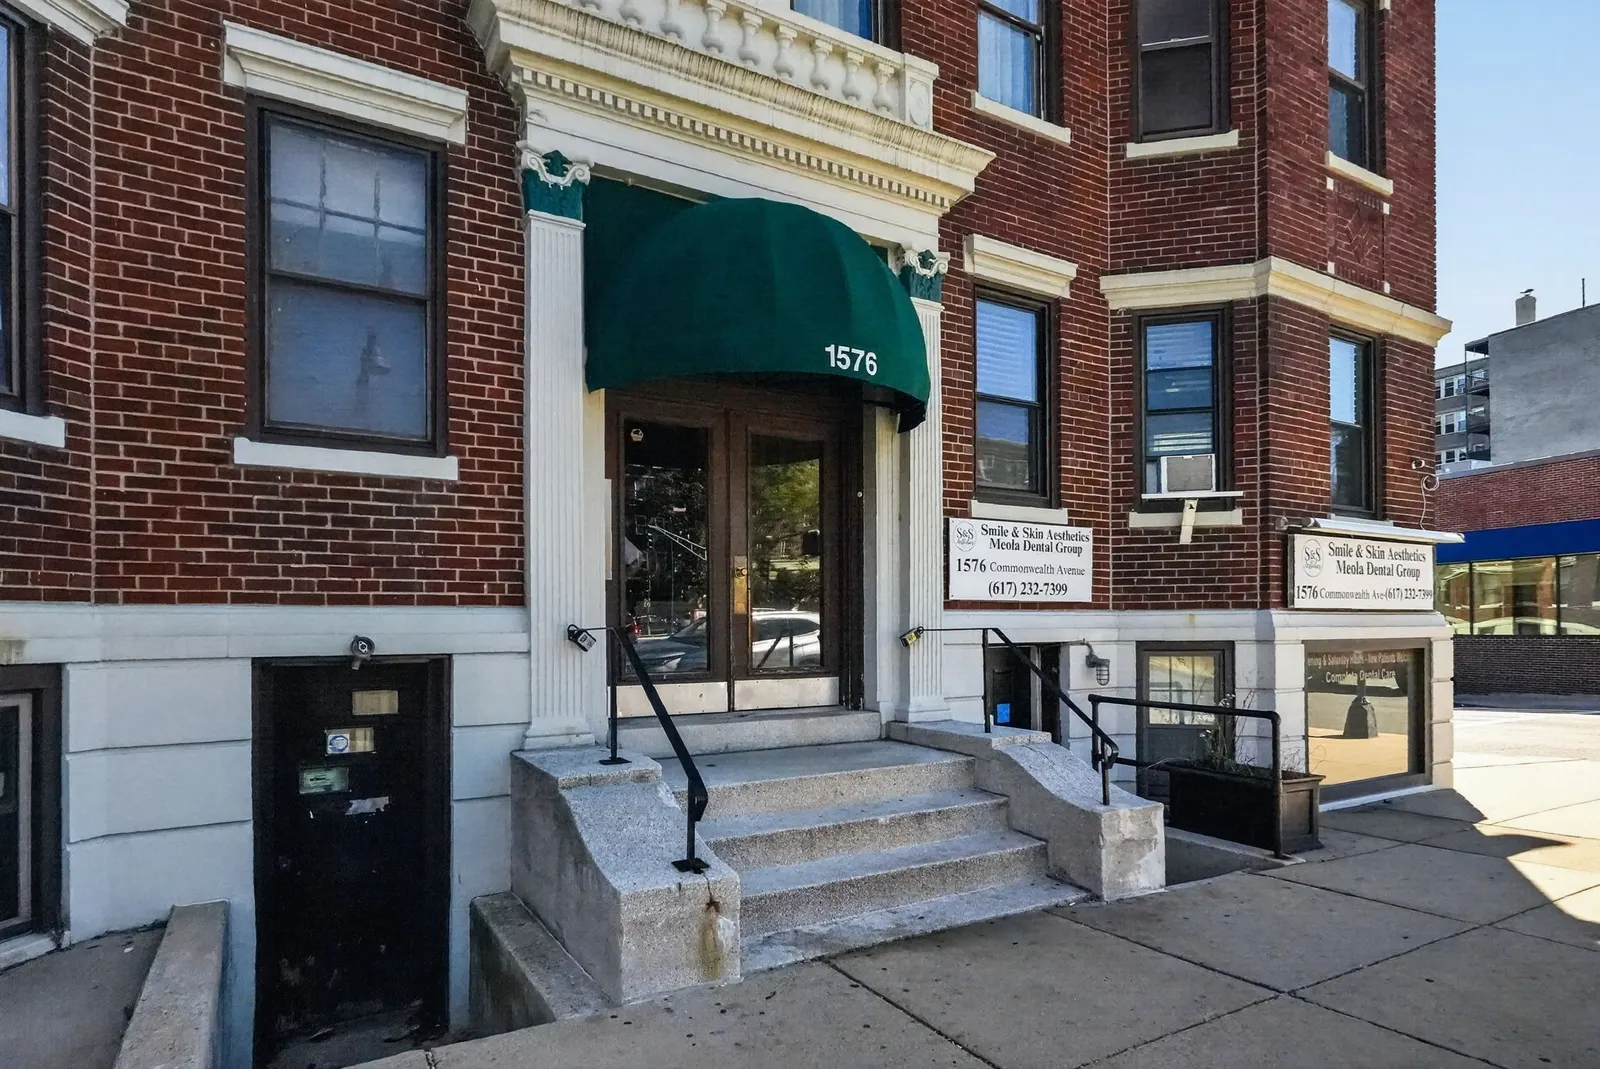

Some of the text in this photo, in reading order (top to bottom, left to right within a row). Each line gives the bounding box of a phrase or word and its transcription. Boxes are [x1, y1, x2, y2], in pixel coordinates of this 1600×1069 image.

[825, 344, 878, 376] 1576
[981, 523, 1090, 542] Smile & Skin Aesthetics
[989, 538, 1020, 551] Meola
[1023, 542, 1053, 553] Dental
[1056, 543, 1083, 557] Group
[1328, 541, 1426, 563] Smile & Skin Aesthetics
[956, 558, 1085, 576] 1576 Commonwealth Avenue
[1336, 560, 1364, 575] Meola
[1367, 562, 1394, 577] Dental
[1396, 564, 1421, 581] Group
[988, 581, 1068, 597] (617) 232-7399
[1296, 585, 1318, 599] 1576
[1320, 588, 1370, 600] Commonwealth
[1360, 669, 1380, 681] Dental
[1381, 668, 1396, 680] Care
